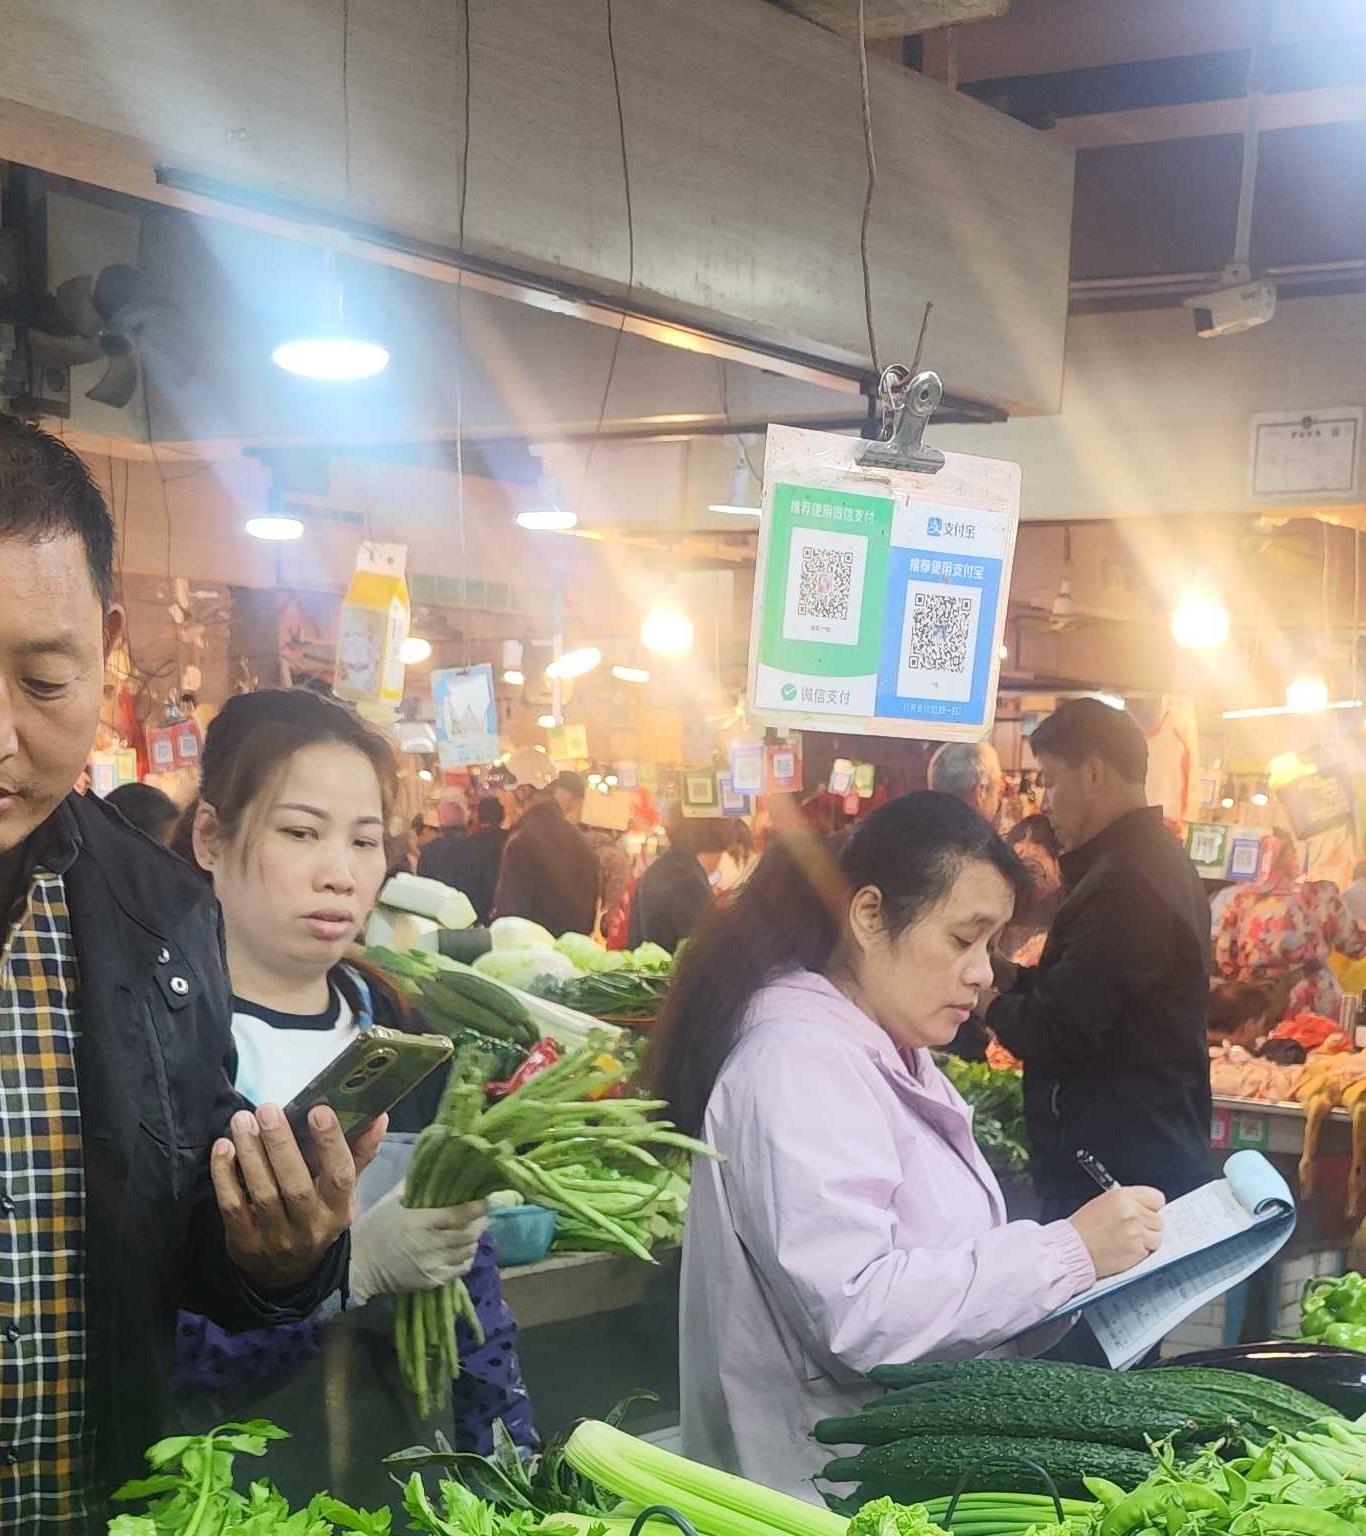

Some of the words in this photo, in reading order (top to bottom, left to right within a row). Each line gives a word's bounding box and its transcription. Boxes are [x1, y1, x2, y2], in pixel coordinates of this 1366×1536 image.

[943, 522, 976, 539] 支付宝
[910, 558, 985, 580] 推荐使用支付宝
[800, 687, 851, 705] 微信支付
